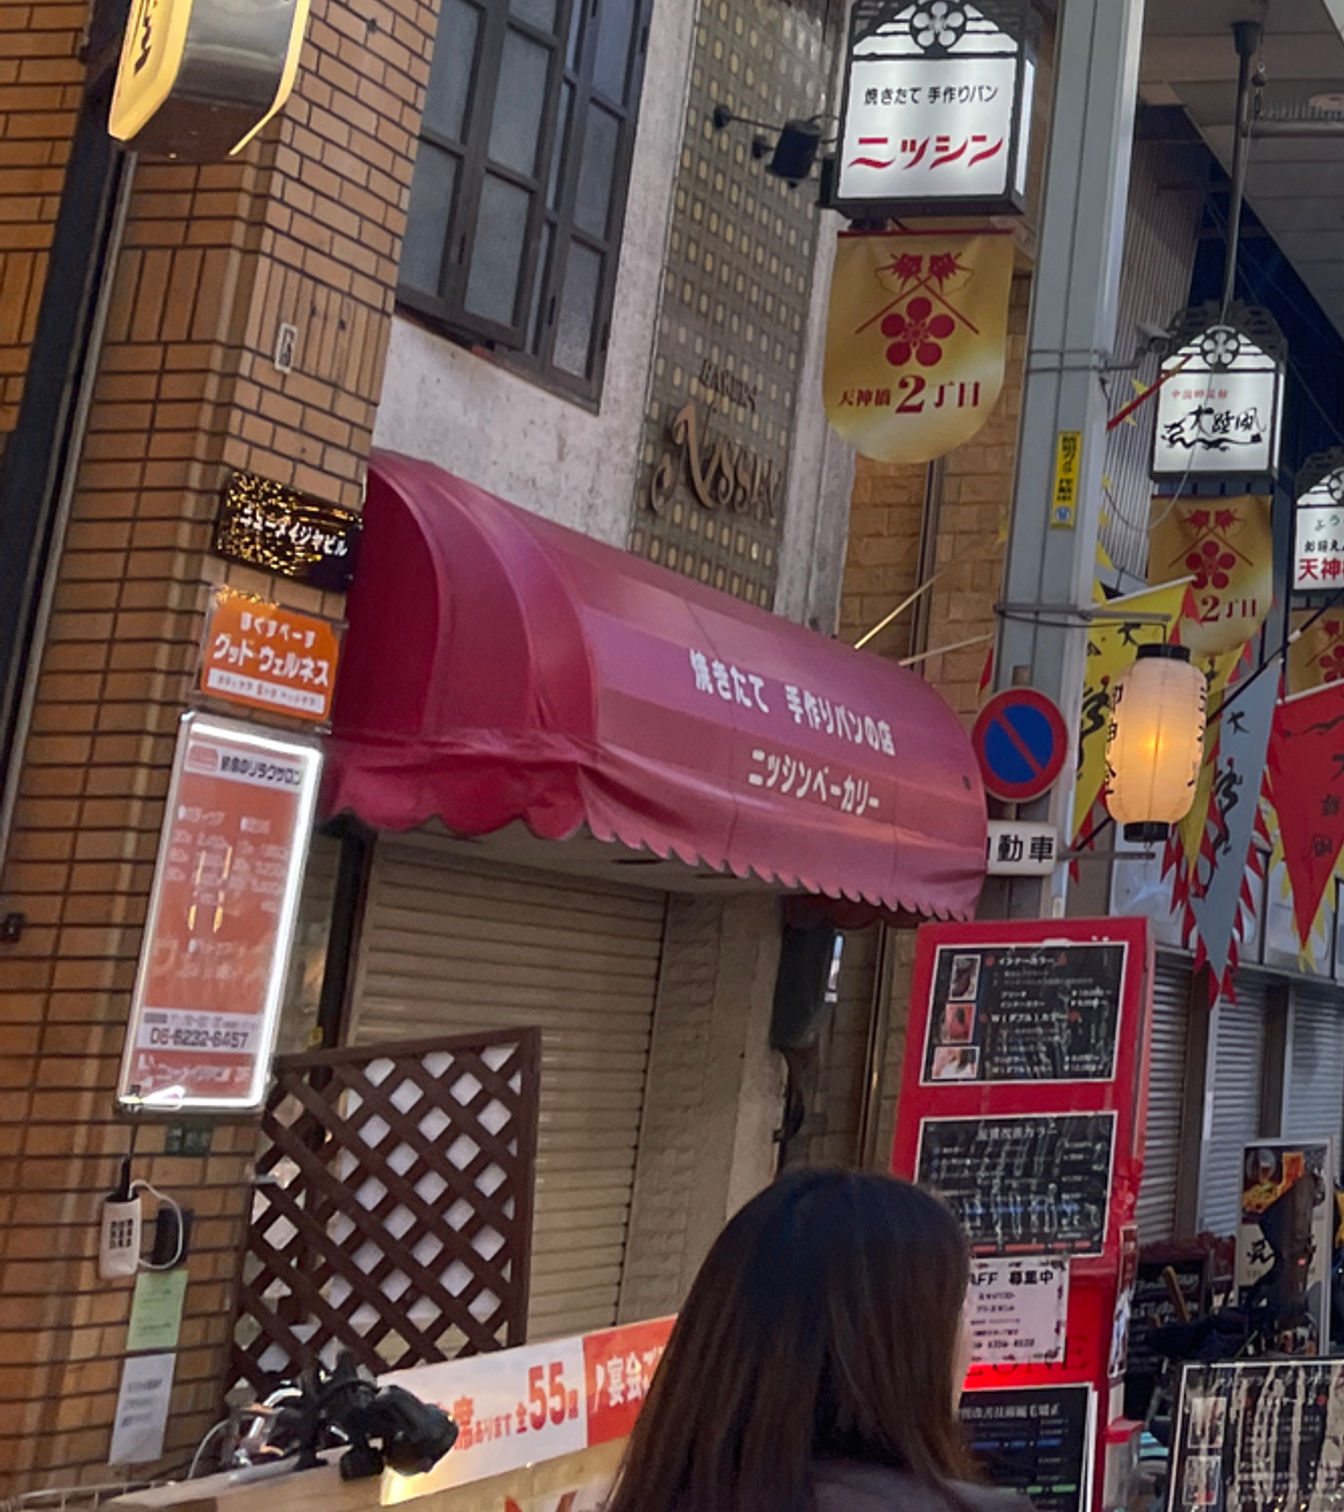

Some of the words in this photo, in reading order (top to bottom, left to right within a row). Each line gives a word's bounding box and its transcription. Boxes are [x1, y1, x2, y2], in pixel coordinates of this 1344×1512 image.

[863, 86, 922, 106] 焼きたて
[927, 85, 999, 105] 手作りパン
[848, 134, 1004, 171] ニッシン
[688, 648, 771, 714] 焼きたて
[784, 684, 897, 757] 手作りパンの店
[747, 748, 880, 817] ニッシンベーカリー
[986, 833, 1055, 864] 動車
